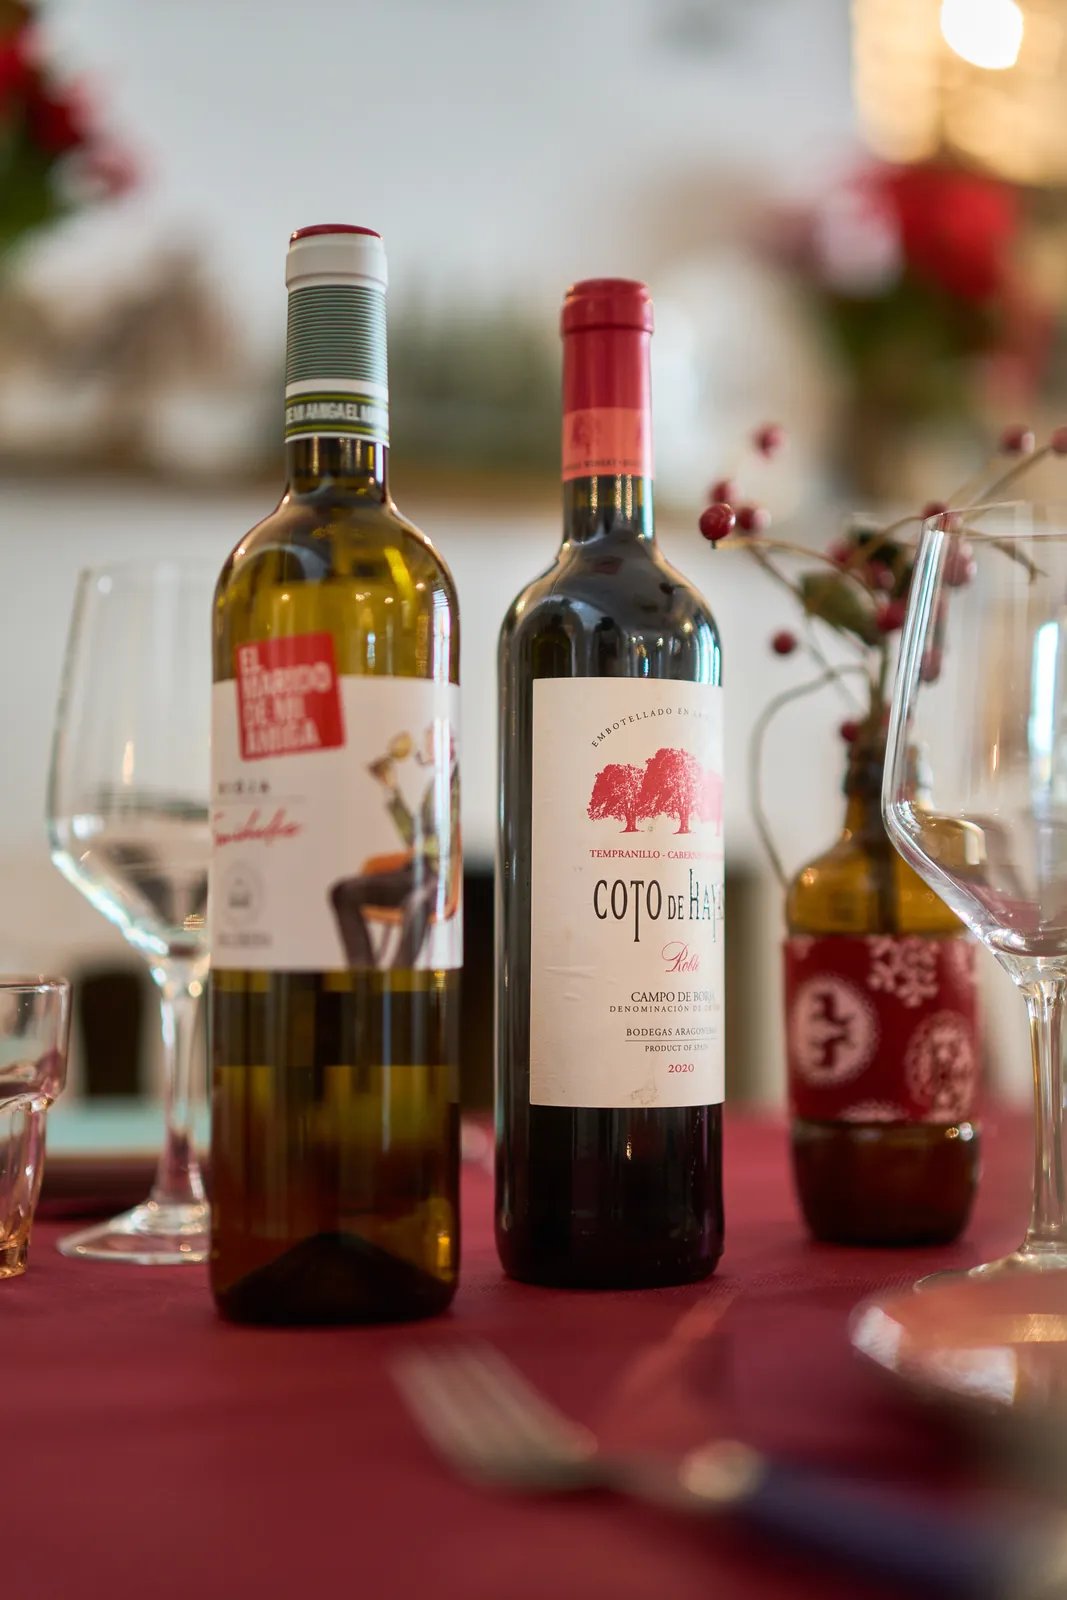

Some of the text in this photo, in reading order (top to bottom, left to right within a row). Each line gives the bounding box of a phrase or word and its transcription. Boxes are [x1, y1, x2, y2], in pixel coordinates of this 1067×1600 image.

[591, 707, 674, 748] EMBOTELLADO
[590, 849, 661, 860] TEMPRANILLO
[593, 879, 662, 942] COTO
[667, 895, 684, 920] DE
[630, 991, 676, 1003] CAMPO
[677, 991, 692, 1003] DE
[609, 1004, 689, 1014] DENOMINACIÓN
[626, 1028, 673, 1037] BODEGAS
[645, 1045, 682, 1053] PRODUCT
[683, 1044, 693, 1052] OF
[668, 1063, 695, 1074] 2020
